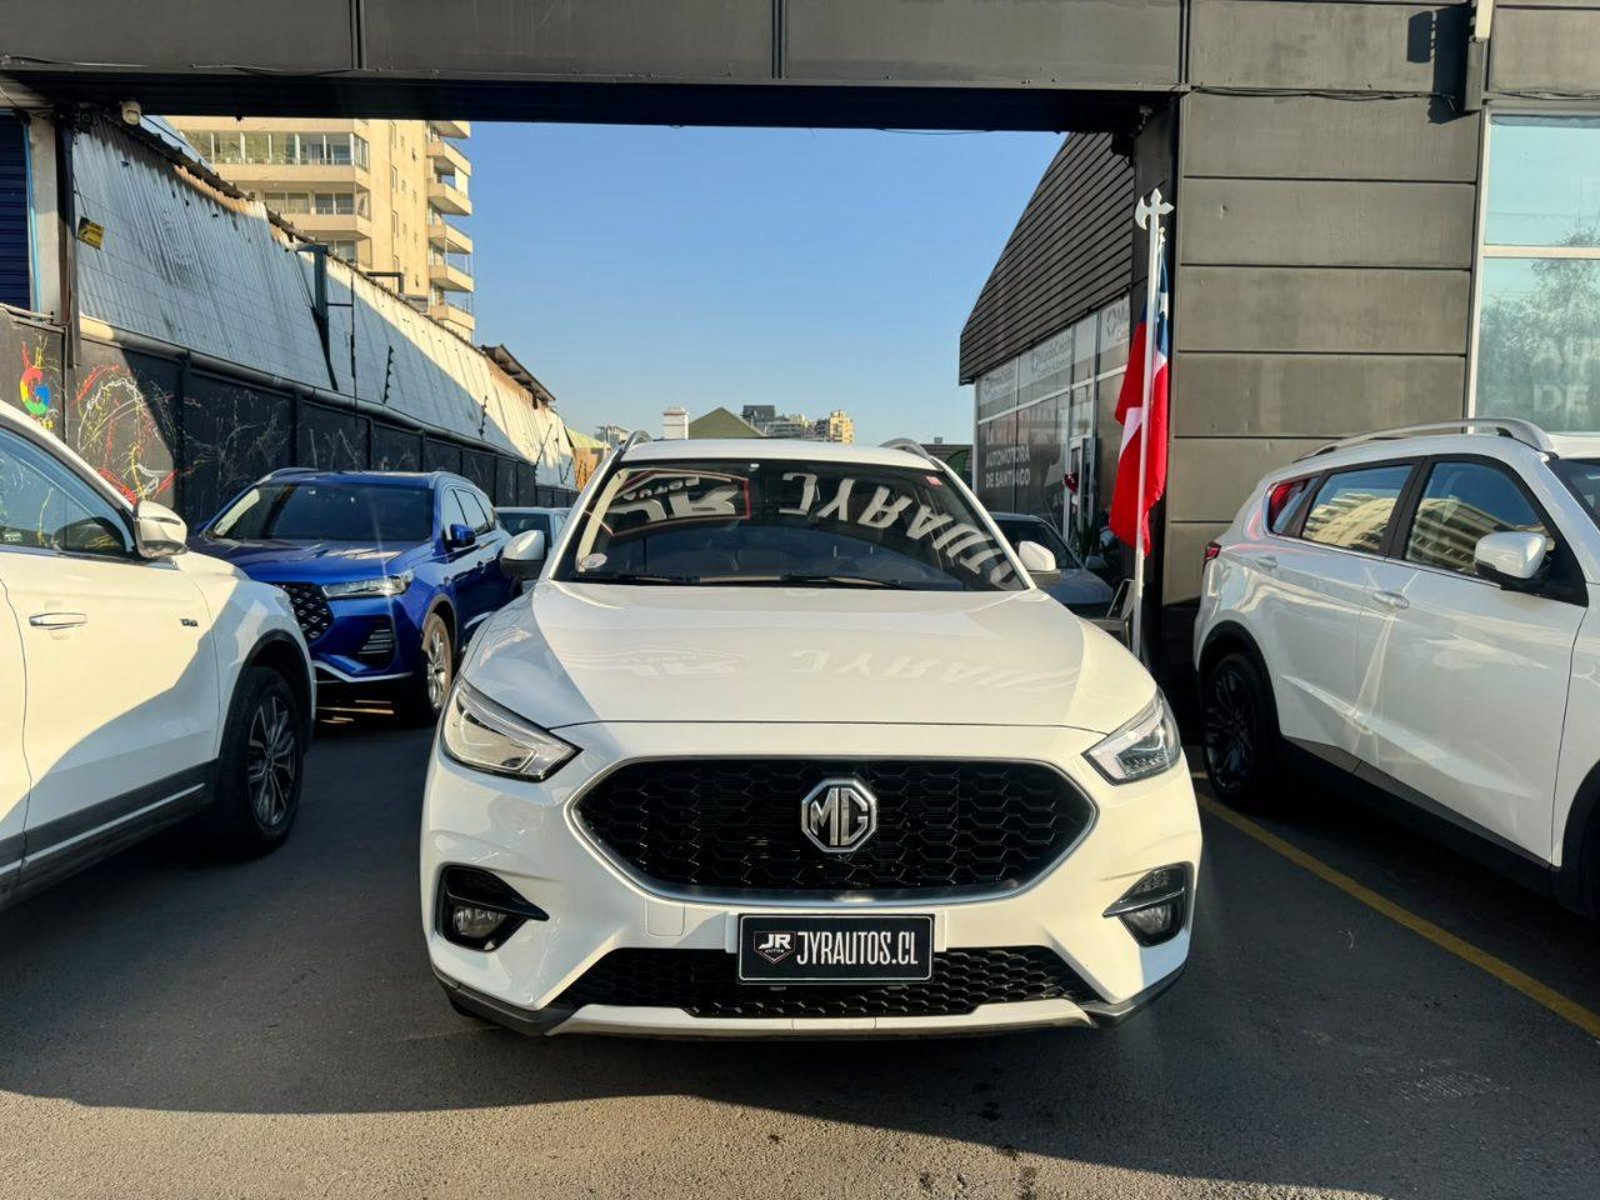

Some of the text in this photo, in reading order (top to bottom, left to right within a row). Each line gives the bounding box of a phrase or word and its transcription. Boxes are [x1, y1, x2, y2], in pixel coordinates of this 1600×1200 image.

[809, 786, 870, 847] MG
[758, 931, 918, 965] JR JYRAUTOS.CL
